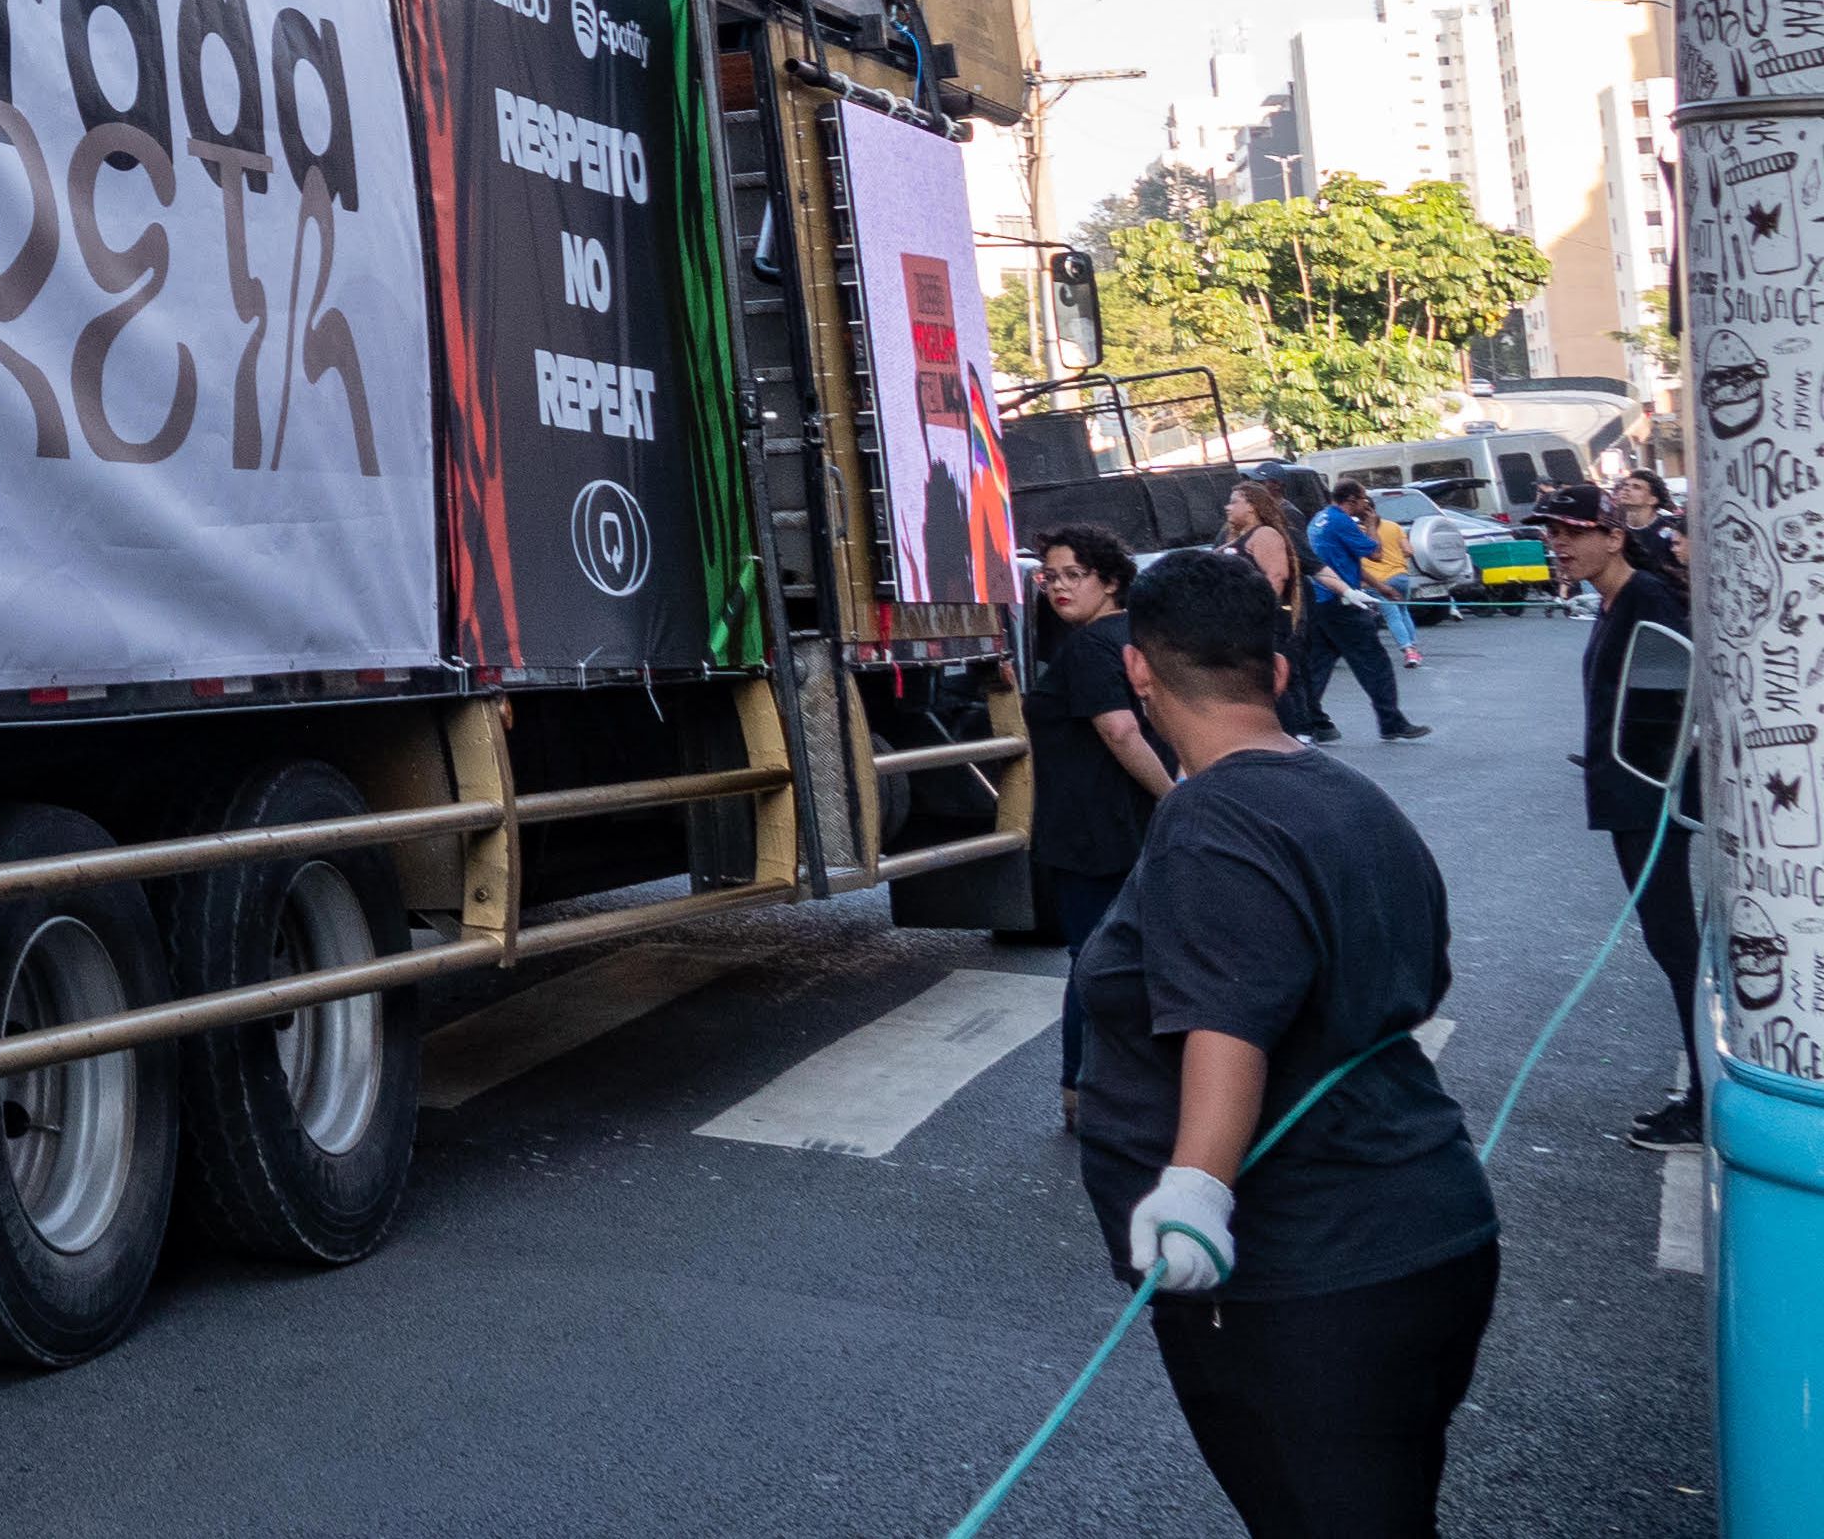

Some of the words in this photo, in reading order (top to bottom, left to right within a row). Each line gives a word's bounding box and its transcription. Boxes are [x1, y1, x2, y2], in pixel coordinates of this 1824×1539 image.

[599, 10, 651, 69] Spotify
[495, 88, 649, 203] RESPEITO
[563, 231, 612, 314] NO
[534, 349, 655, 442] REPEAT
